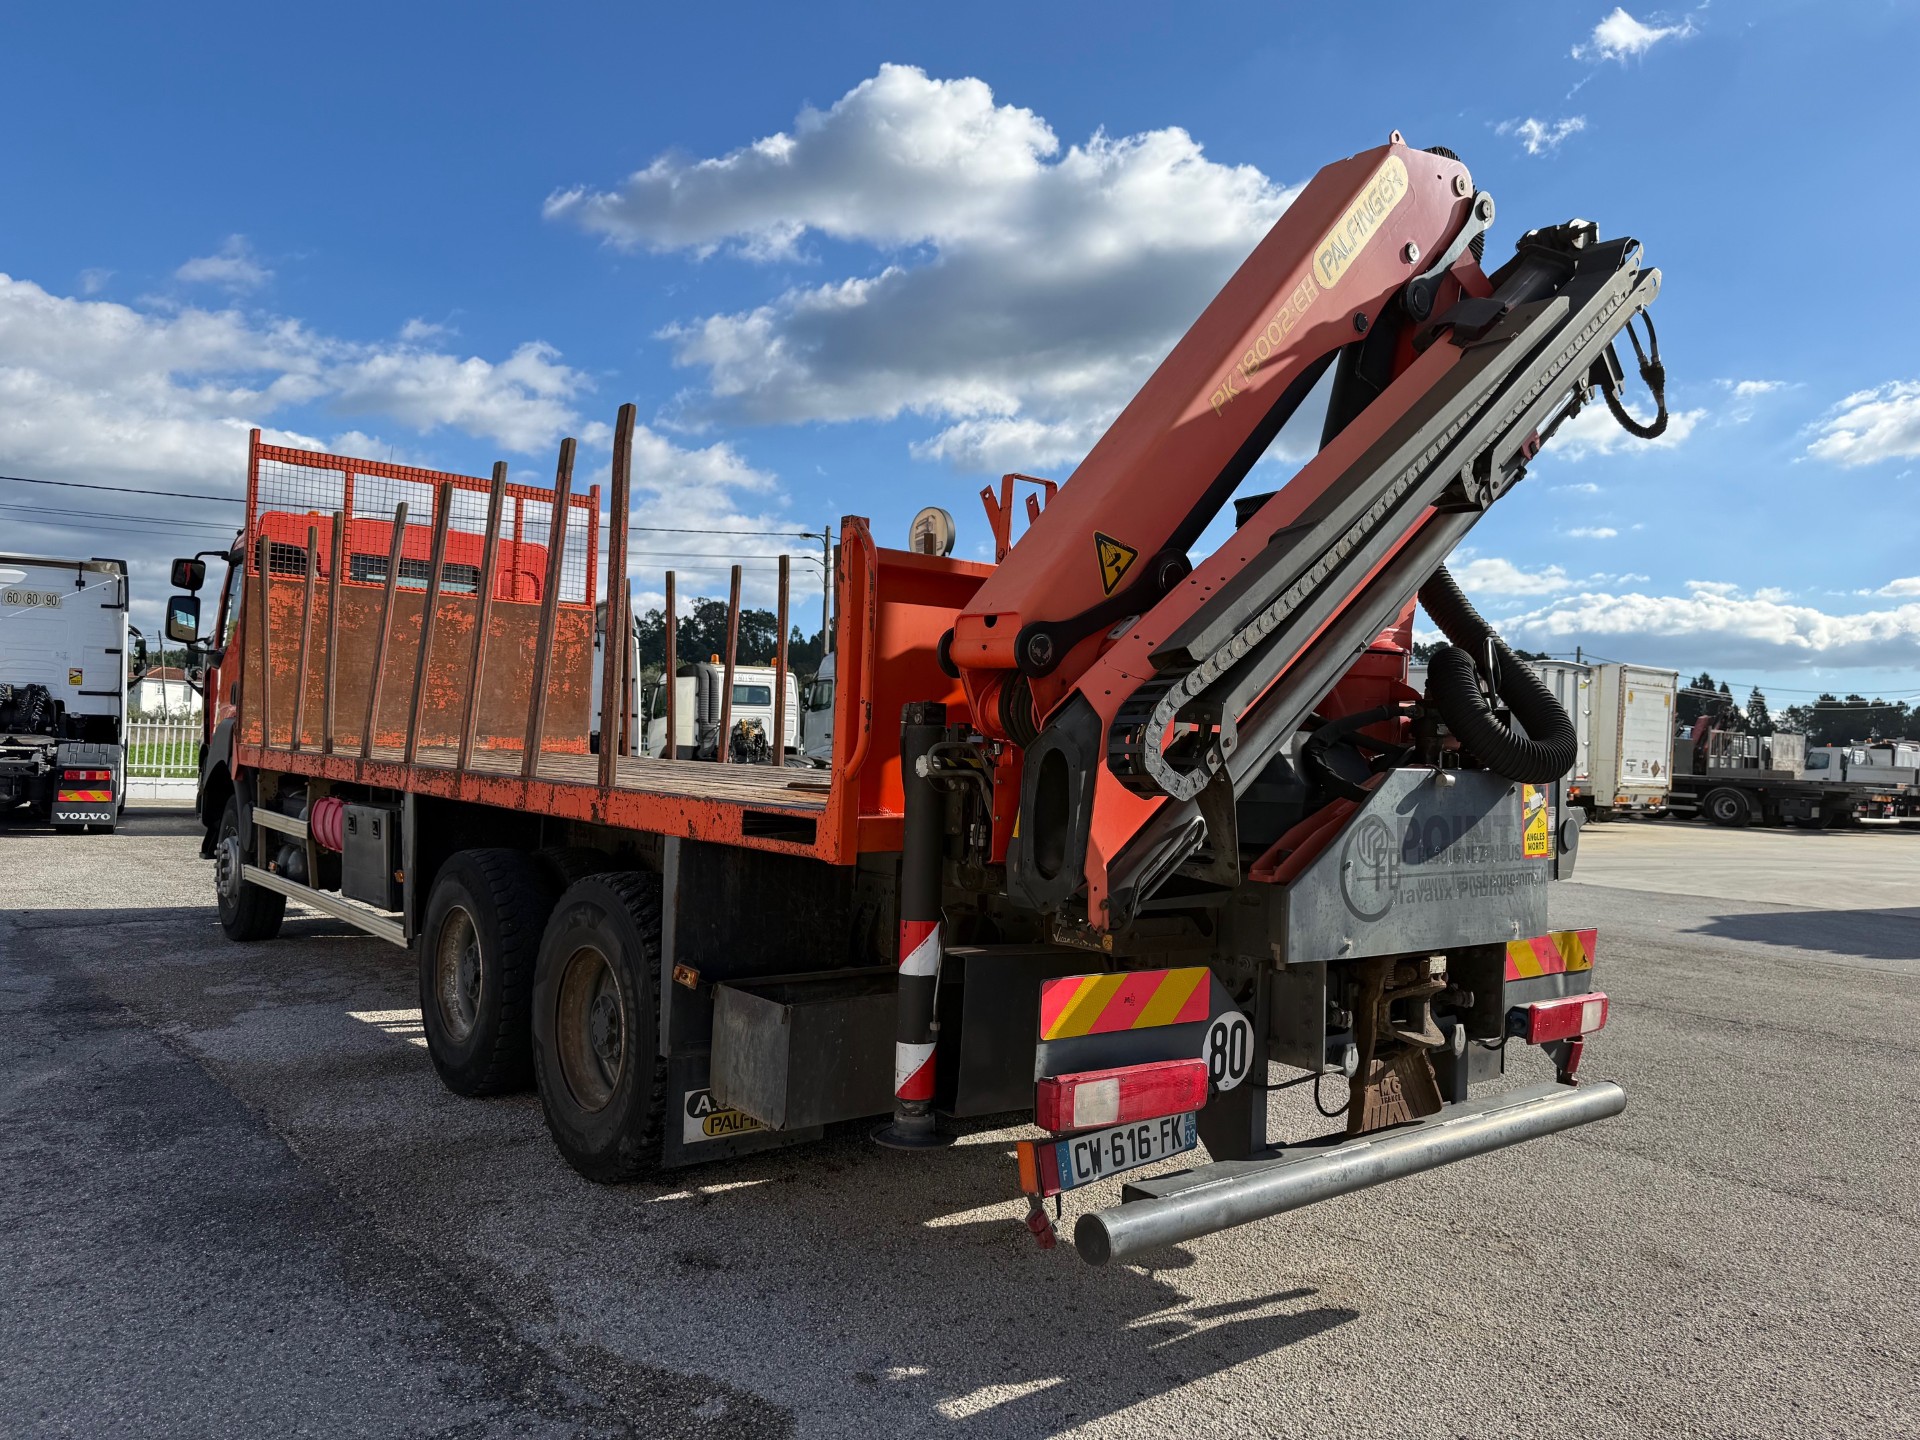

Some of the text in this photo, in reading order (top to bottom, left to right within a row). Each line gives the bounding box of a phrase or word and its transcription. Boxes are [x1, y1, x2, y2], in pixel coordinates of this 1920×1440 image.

[1319, 165, 1404, 281] PALFINGER
[1209, 373, 1240, 418] PK
[7, 591, 57, 606] 60 80 90
[56, 812, 111, 820] VOLVO
[1526, 832, 1545, 841] ANGLES
[1527, 842, 1544, 851] MORTS
[1389, 878, 1453, 905] Travaux
[1209, 1020, 1246, 1082] 80
[1074, 1115, 1182, 1179] CW-616-FK
[1185, 1134, 1196, 1150] 33
[1062, 1170, 1068, 1181] F
